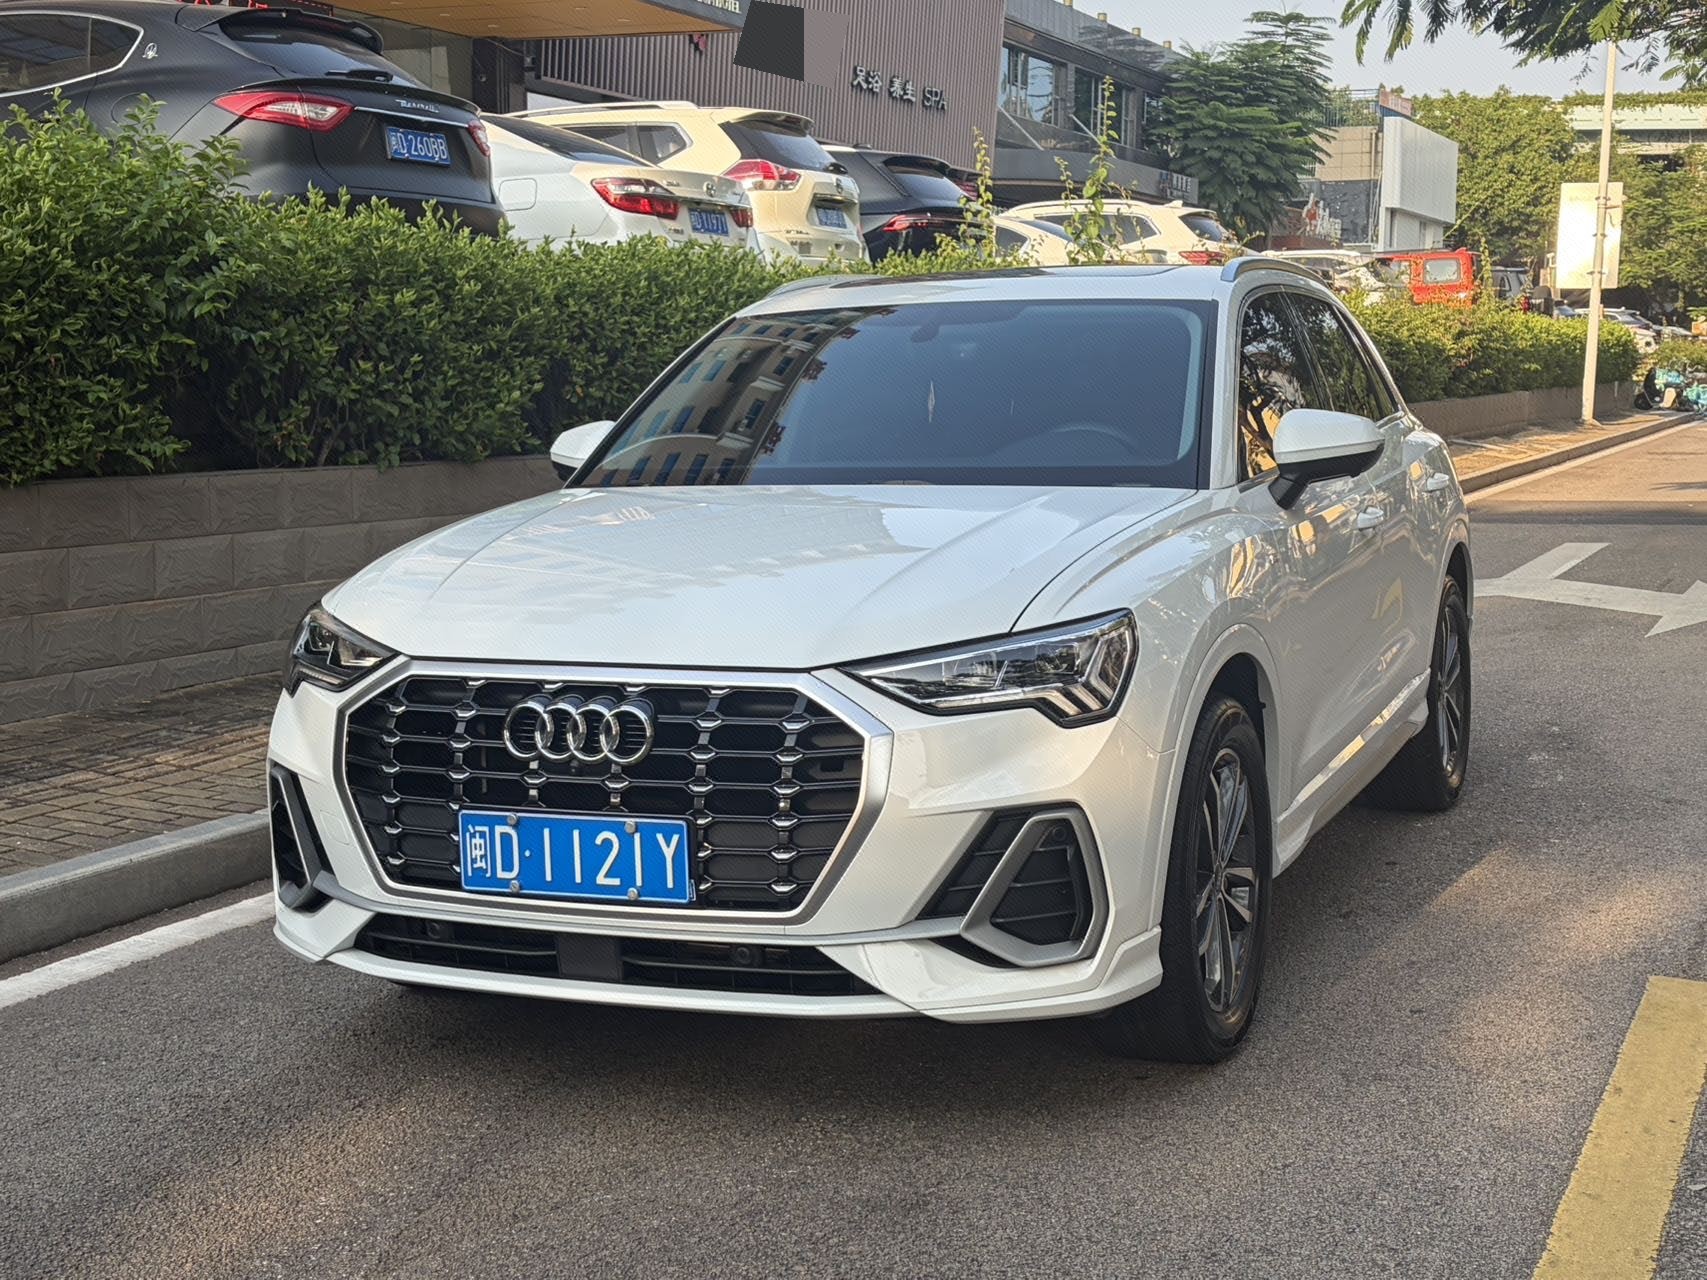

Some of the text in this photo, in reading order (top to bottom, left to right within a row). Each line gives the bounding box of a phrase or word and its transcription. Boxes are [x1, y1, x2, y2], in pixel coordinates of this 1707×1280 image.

[852, 65, 947, 110] 足浴 养生 SPA
